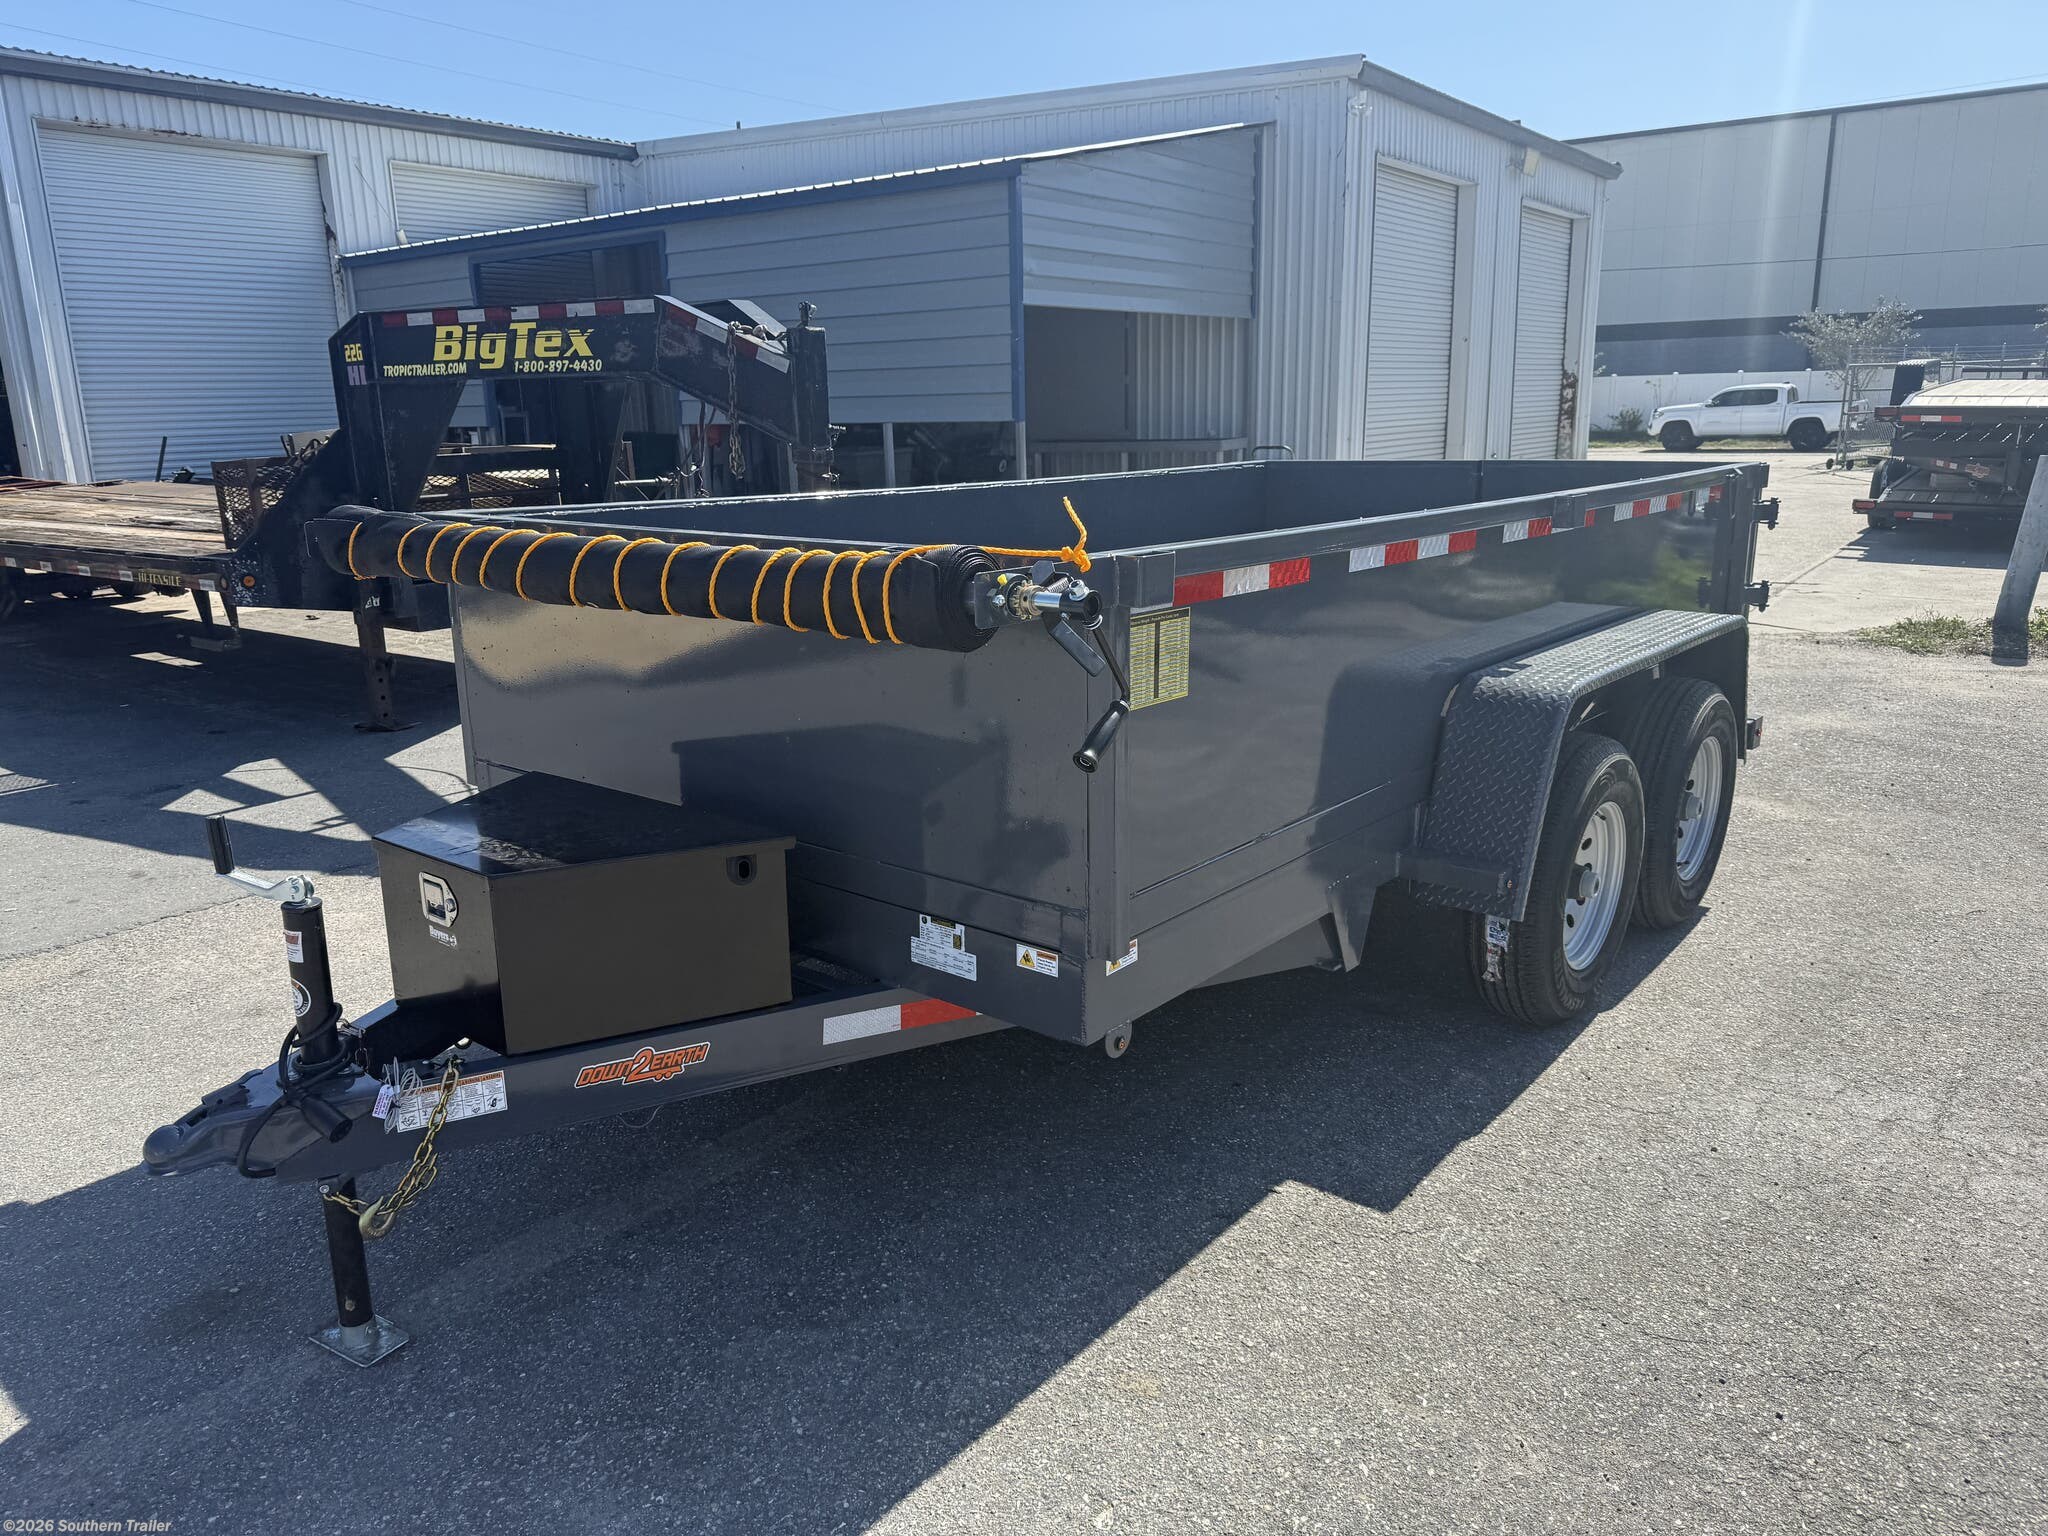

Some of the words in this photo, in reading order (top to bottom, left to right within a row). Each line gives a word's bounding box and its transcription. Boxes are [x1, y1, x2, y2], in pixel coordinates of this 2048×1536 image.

[433, 321, 595, 370] BigTex
[382, 362, 467, 378] TROPICTRAILER.COM
[513, 358, 603, 375] 1-800-897-4430
